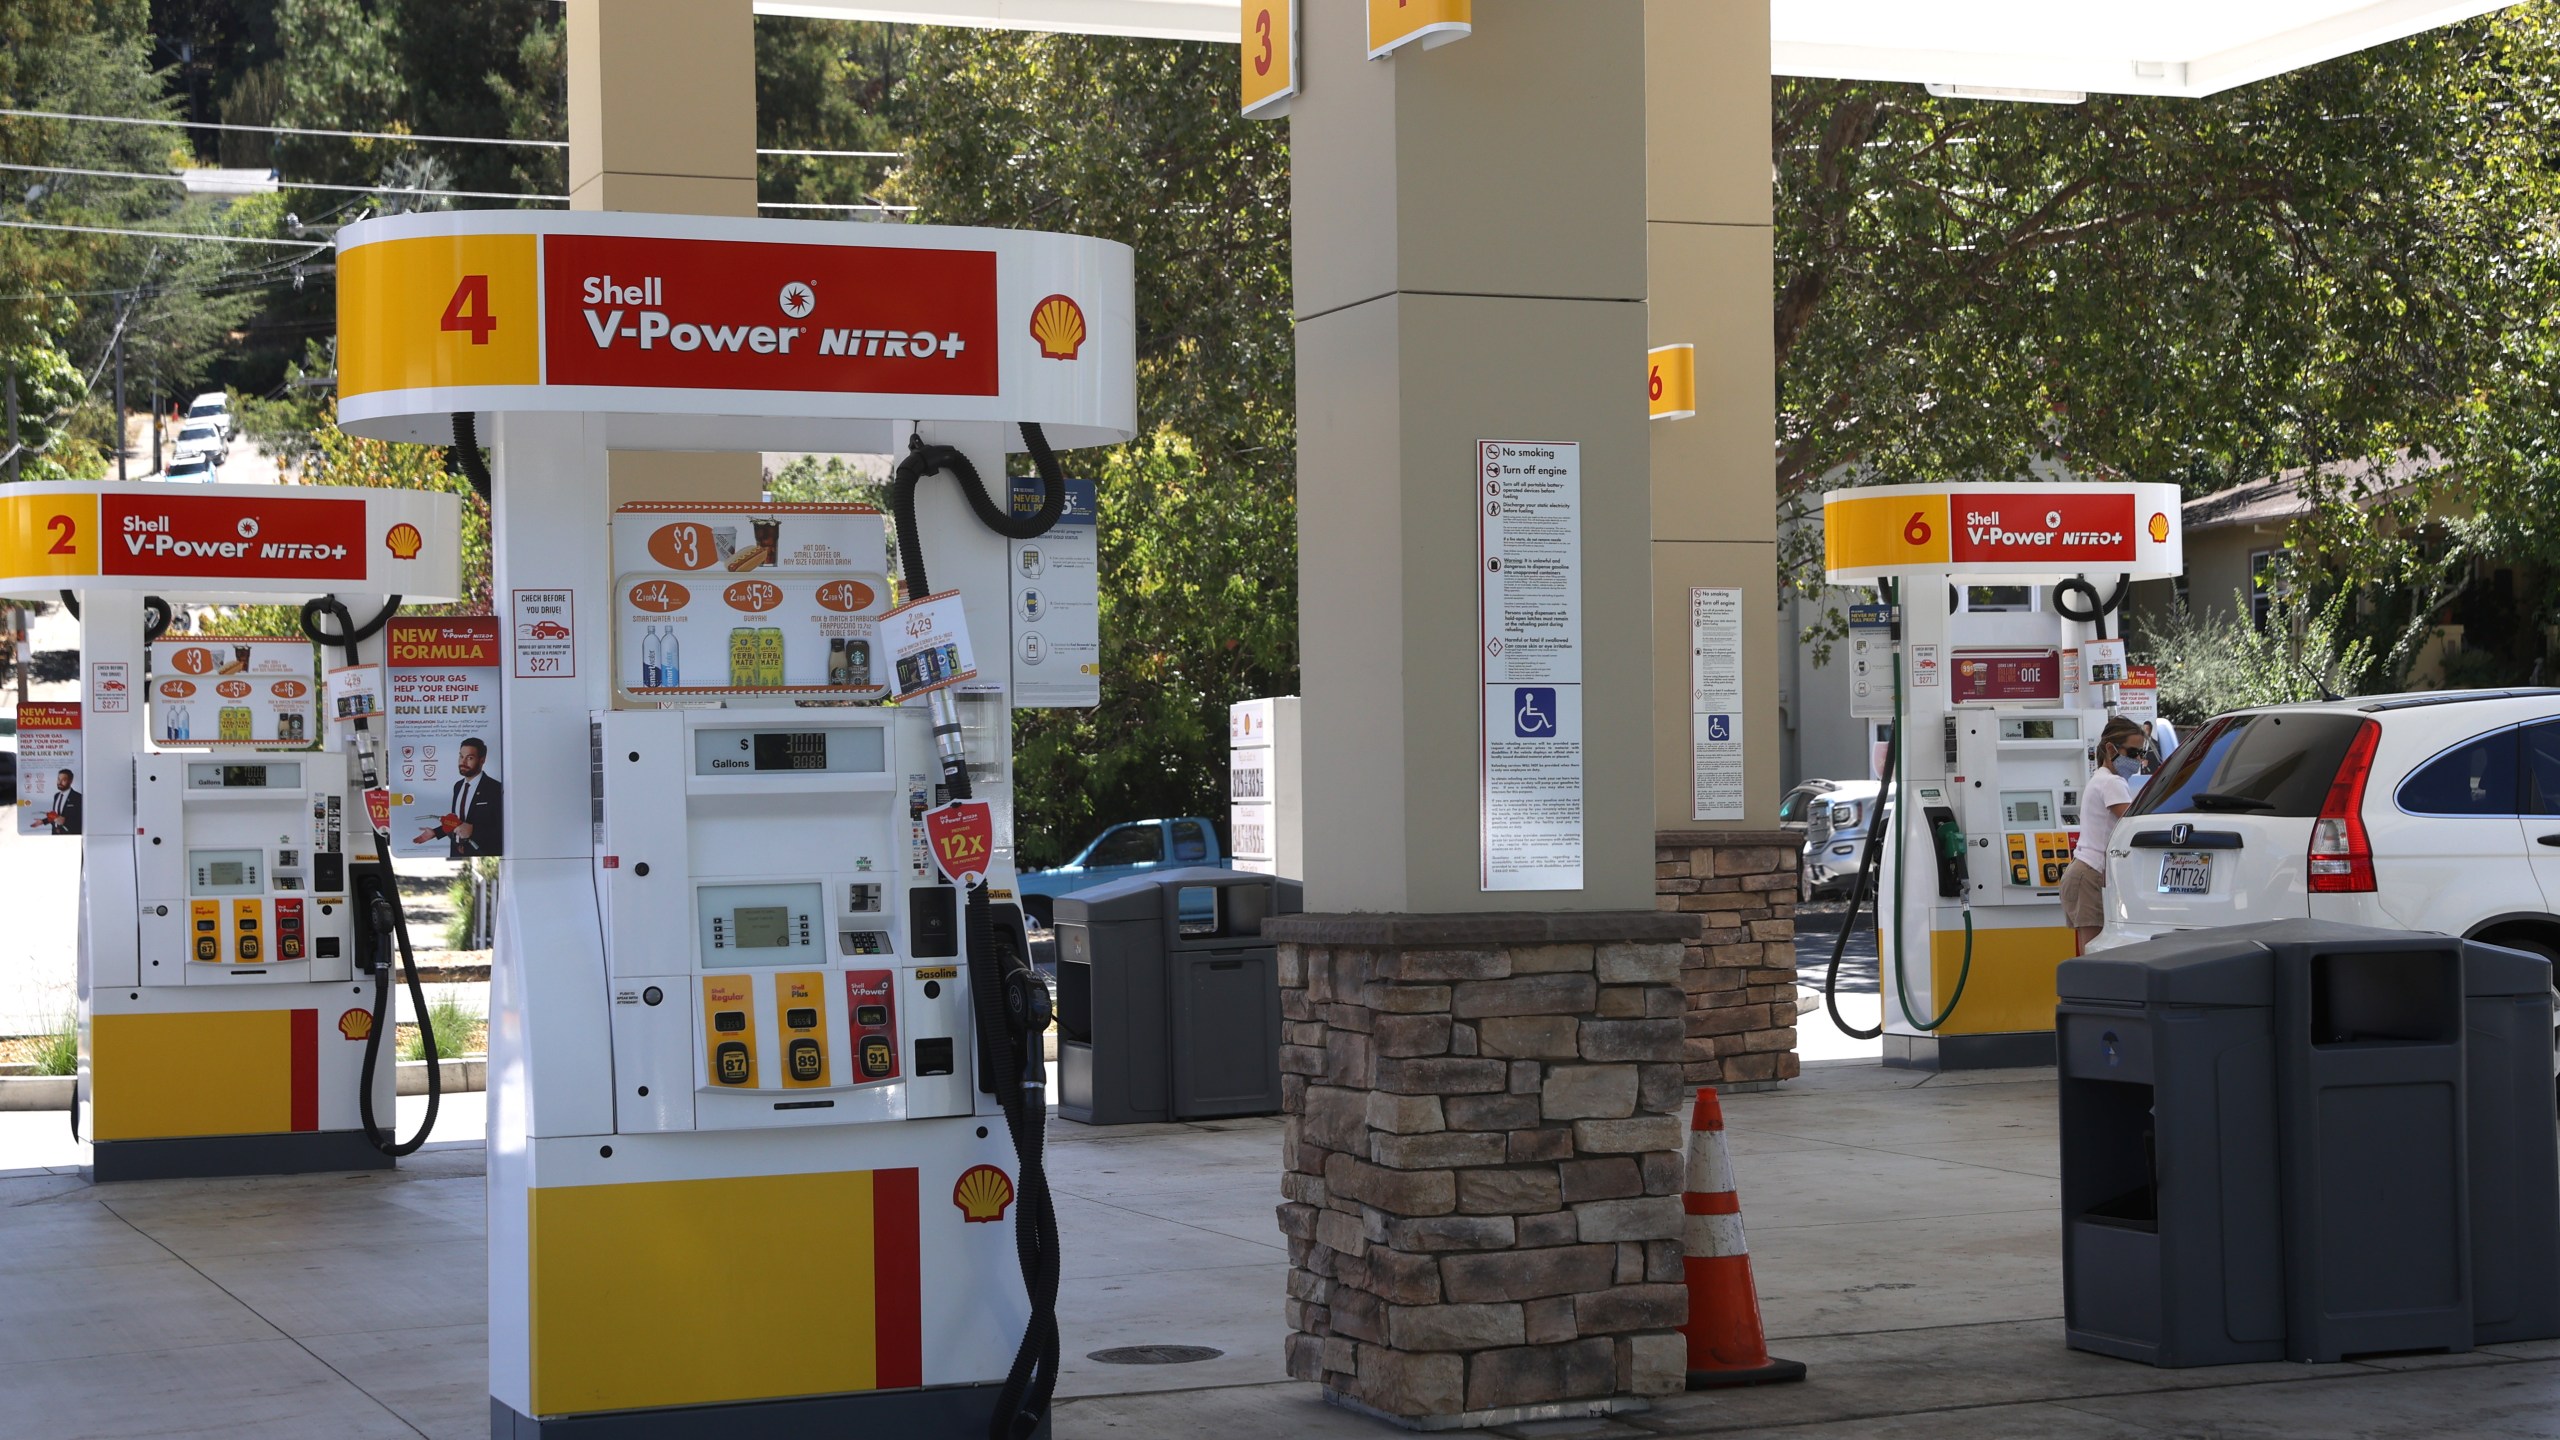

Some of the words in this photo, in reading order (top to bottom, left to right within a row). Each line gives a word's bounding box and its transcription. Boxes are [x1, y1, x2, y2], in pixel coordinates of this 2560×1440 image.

[1254, 9, 1272, 76] 3
[582, 276, 662, 306] Shell
[440, 274, 497, 345] 4
[583, 309, 798, 354] V-Power
[1648, 366, 1662, 401] 6
[1503, 448, 1515, 456] No
[1518, 448, 1554, 459] smoking
[1503, 465, 1520, 474] Turn
[1524, 465, 1535, 474] off
[1538, 467, 1567, 477] engine
[1014, 494, 1040, 502] NEVER
[1014, 504, 1032, 512] FULL
[123, 515, 169, 532] Shell
[1966, 512, 1999, 526] Shell
[47, 514, 76, 554] 2
[1904, 512, 1932, 545] 6
[1967, 527, 2054, 545] V-Power
[123, 534, 250, 558] V-Power
[674, 526, 698, 567] $3
[808, 558, 833, 566] FOUNTAIN
[636, 589, 642, 601] 2
[652, 584, 669, 610] $4
[730, 590, 736, 601] 2
[822, 589, 828, 601] 2
[838, 584, 853, 610] $6
[526, 606, 539, 614] YOU
[393, 629, 437, 642] NEW
[393, 645, 484, 659] FORMULA
[187, 650, 202, 673] $3
[531, 657, 559, 672] $271
[2022, 668, 2040, 682] ONE
[20, 708, 45, 716] NEW
[395, 706, 420, 714] RUN
[424, 706, 448, 714] LIKE
[452, 705, 487, 714] NEW?
[20, 717, 72, 725] FORMULA
[740, 739, 749, 750] $
[712, 759, 749, 768] Gallons
[2173, 857, 2200, 866] California
[2162, 868, 2205, 886] 6TMT726
[916, 969, 957, 979] Gasoline
[712, 994, 744, 1002] Regular
[792, 990, 808, 998] Plus
[852, 988, 886, 996] V-Power
[798, 1056, 816, 1067] 89
[869, 1053, 887, 1064] 91
[725, 1060, 743, 1071] 87
